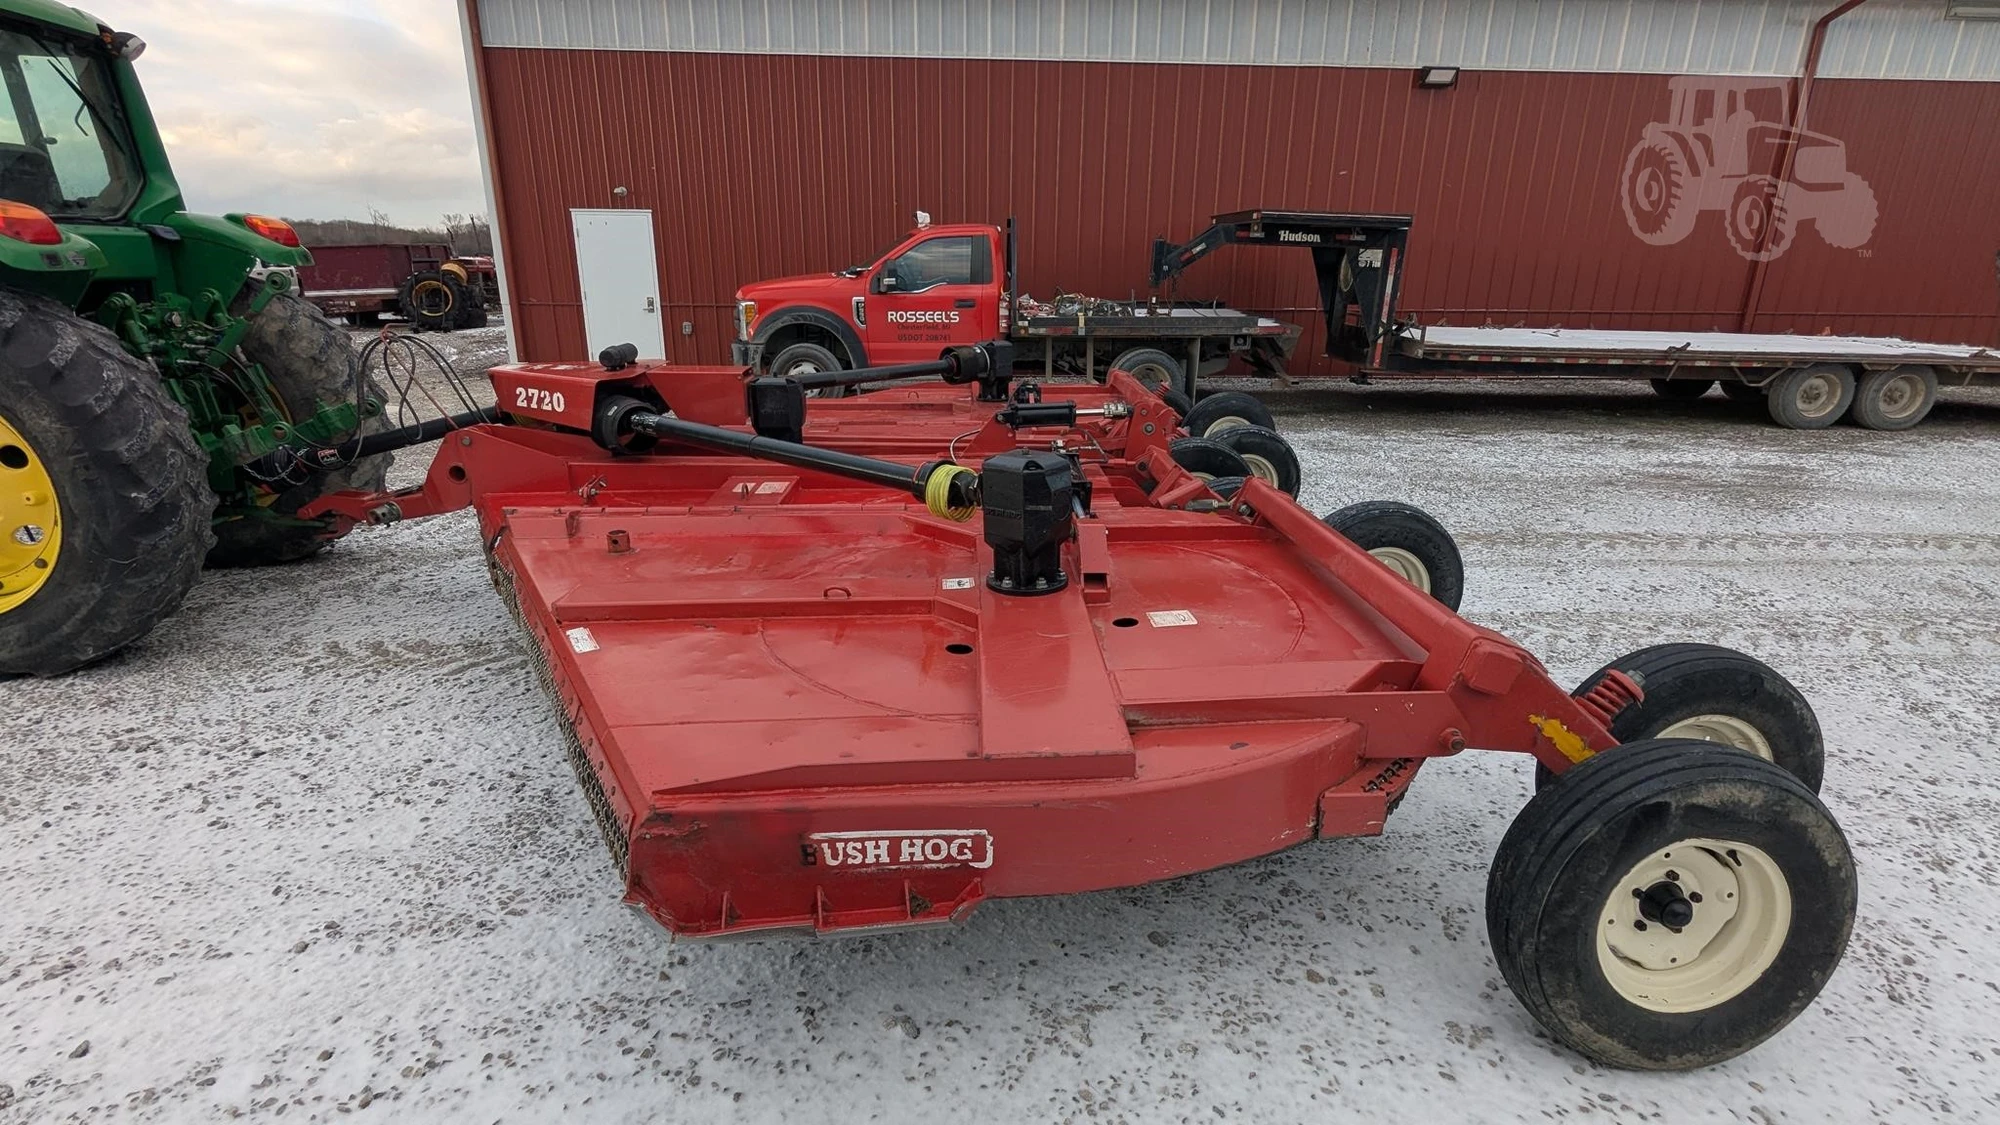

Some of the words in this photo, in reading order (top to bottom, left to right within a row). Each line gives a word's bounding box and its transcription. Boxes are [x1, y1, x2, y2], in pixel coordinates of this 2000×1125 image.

[1279, 230, 1321, 243] Hudson
[887, 311, 960, 323] ROSSEEL'S
[897, 334, 923, 342] USDOT
[515, 386, 565, 413] 2720
[900, 838, 973, 861] HOG
